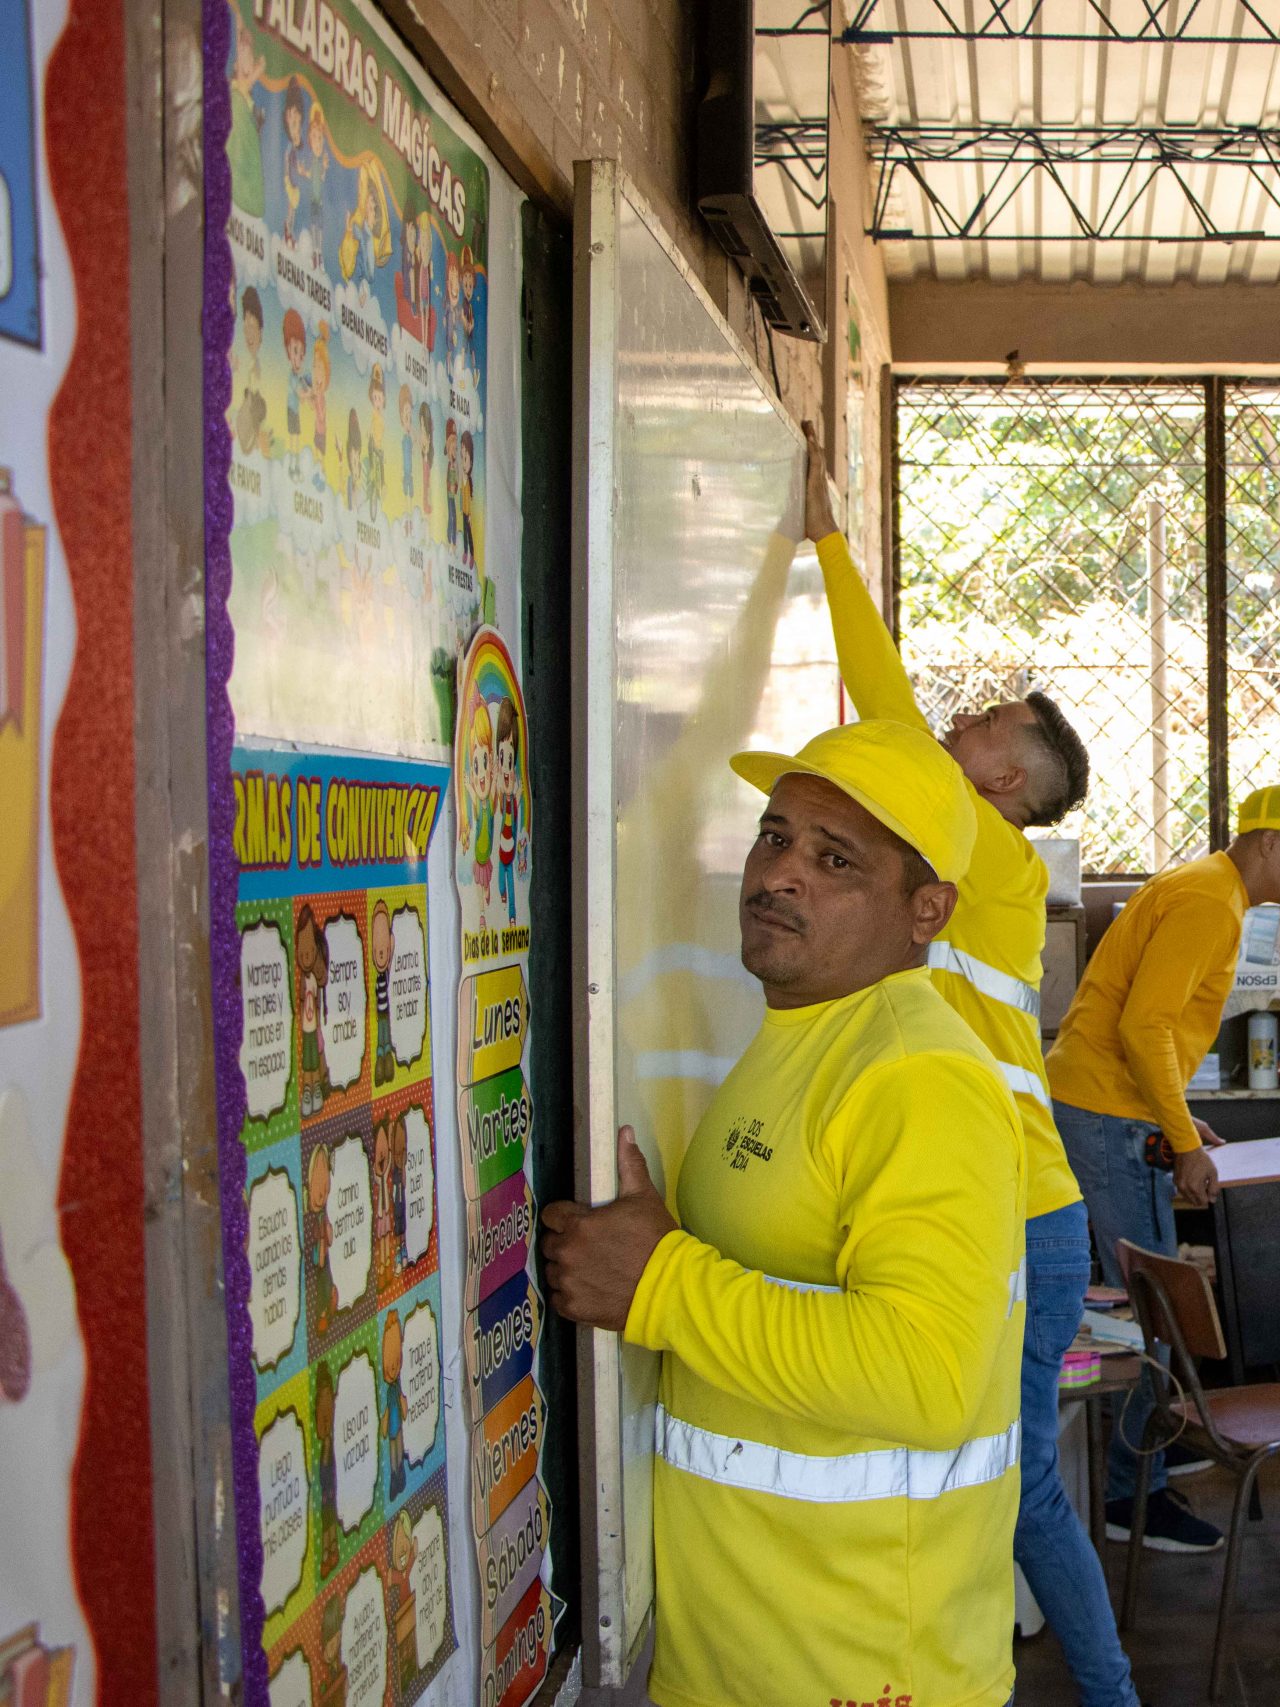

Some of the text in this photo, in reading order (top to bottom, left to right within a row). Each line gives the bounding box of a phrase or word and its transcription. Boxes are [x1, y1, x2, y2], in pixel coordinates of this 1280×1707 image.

[255, 0, 379, 119] ALABRAS
[277, 251, 331, 312] BUENAS TARDES
[341, 304, 388, 357] BUENAS NOCHES
[405, 351, 428, 387] LO SIENTO
[449, 389, 471, 418] DE NADA
[294, 490, 324, 524] GRACIAS
[357, 520, 381, 549] PERMISO
[448, 564, 472, 592] ME PRESTAS
[297, 777, 322, 867] DE
[327, 780, 440, 864] CONVIVENCIA
[480, 929, 490, 957] de
[491, 928, 498, 955] la
[501, 928, 529, 953] semana
[247, 961, 282, 989] Mantengo
[329, 959, 357, 986] Siempre
[1237, 975, 1277, 986] EPSON
[248, 995, 261, 1020] mis
[262, 992, 277, 1020] pies
[338, 991, 351, 1016] soy
[249, 1021, 285, 1048] manos en
[332, 1018, 357, 1044] amable
[473, 997, 520, 1049] Lunes
[467, 1096, 527, 1164] Martes
[407, 1151, 417, 1172] Soy
[740, 1135, 773, 1161] ESCUELAS
[338, 1182, 359, 1209] Camino
[409, 1195, 425, 1219] amigo
[258, 1207, 288, 1241] Escucho
[470, 1202, 529, 1274] Miércoles
[472, 1300, 532, 1387] Jueves
[476, 1405, 537, 1498] Viernes
[486, 1506, 541, 1610] Sábado
[484, 1605, 545, 1707] Domingo
